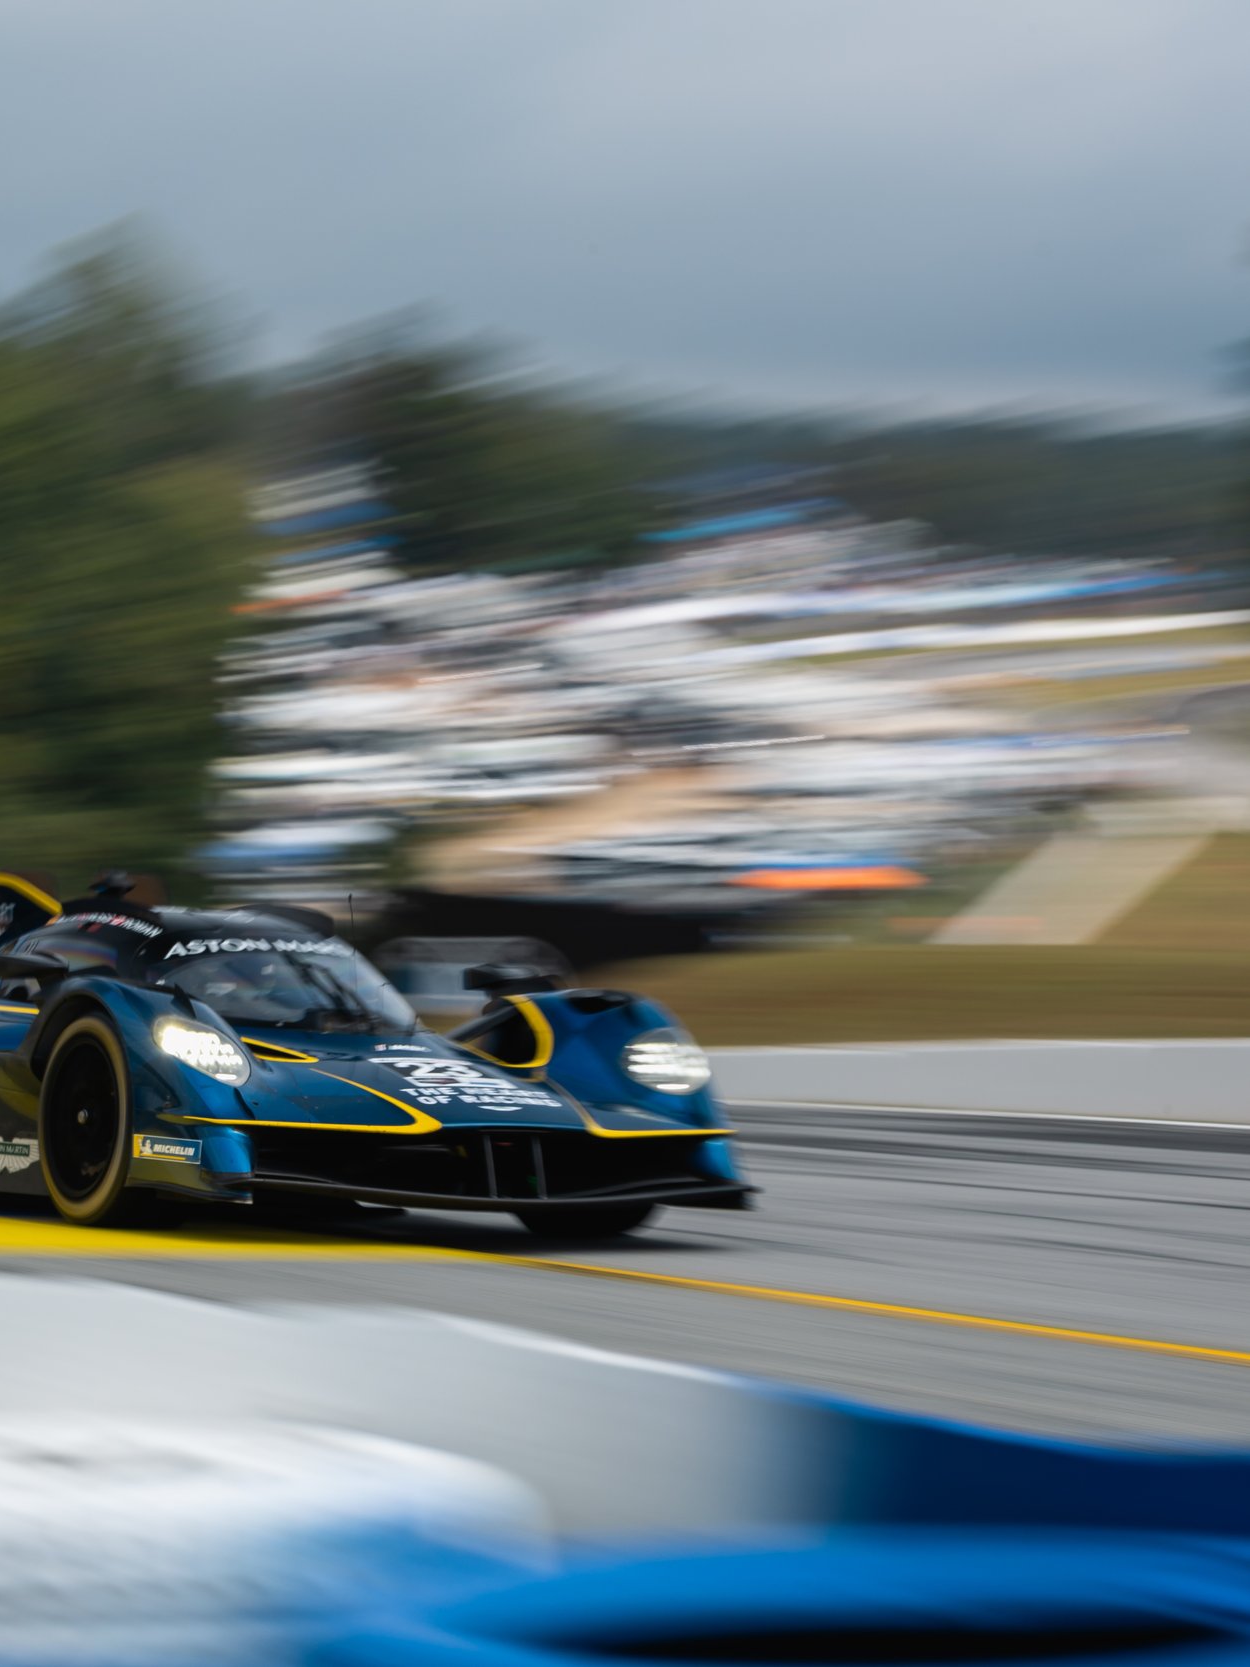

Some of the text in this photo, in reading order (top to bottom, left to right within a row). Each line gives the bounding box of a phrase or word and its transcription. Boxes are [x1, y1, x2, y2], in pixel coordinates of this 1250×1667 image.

[163, 938, 272, 960] ASTON
[400, 1087, 459, 1096] THE
[416, 1095, 452, 1105] OF
[6, 1144, 29, 1155] MARTIN
[153, 1144, 195, 1156] MICHELIN
